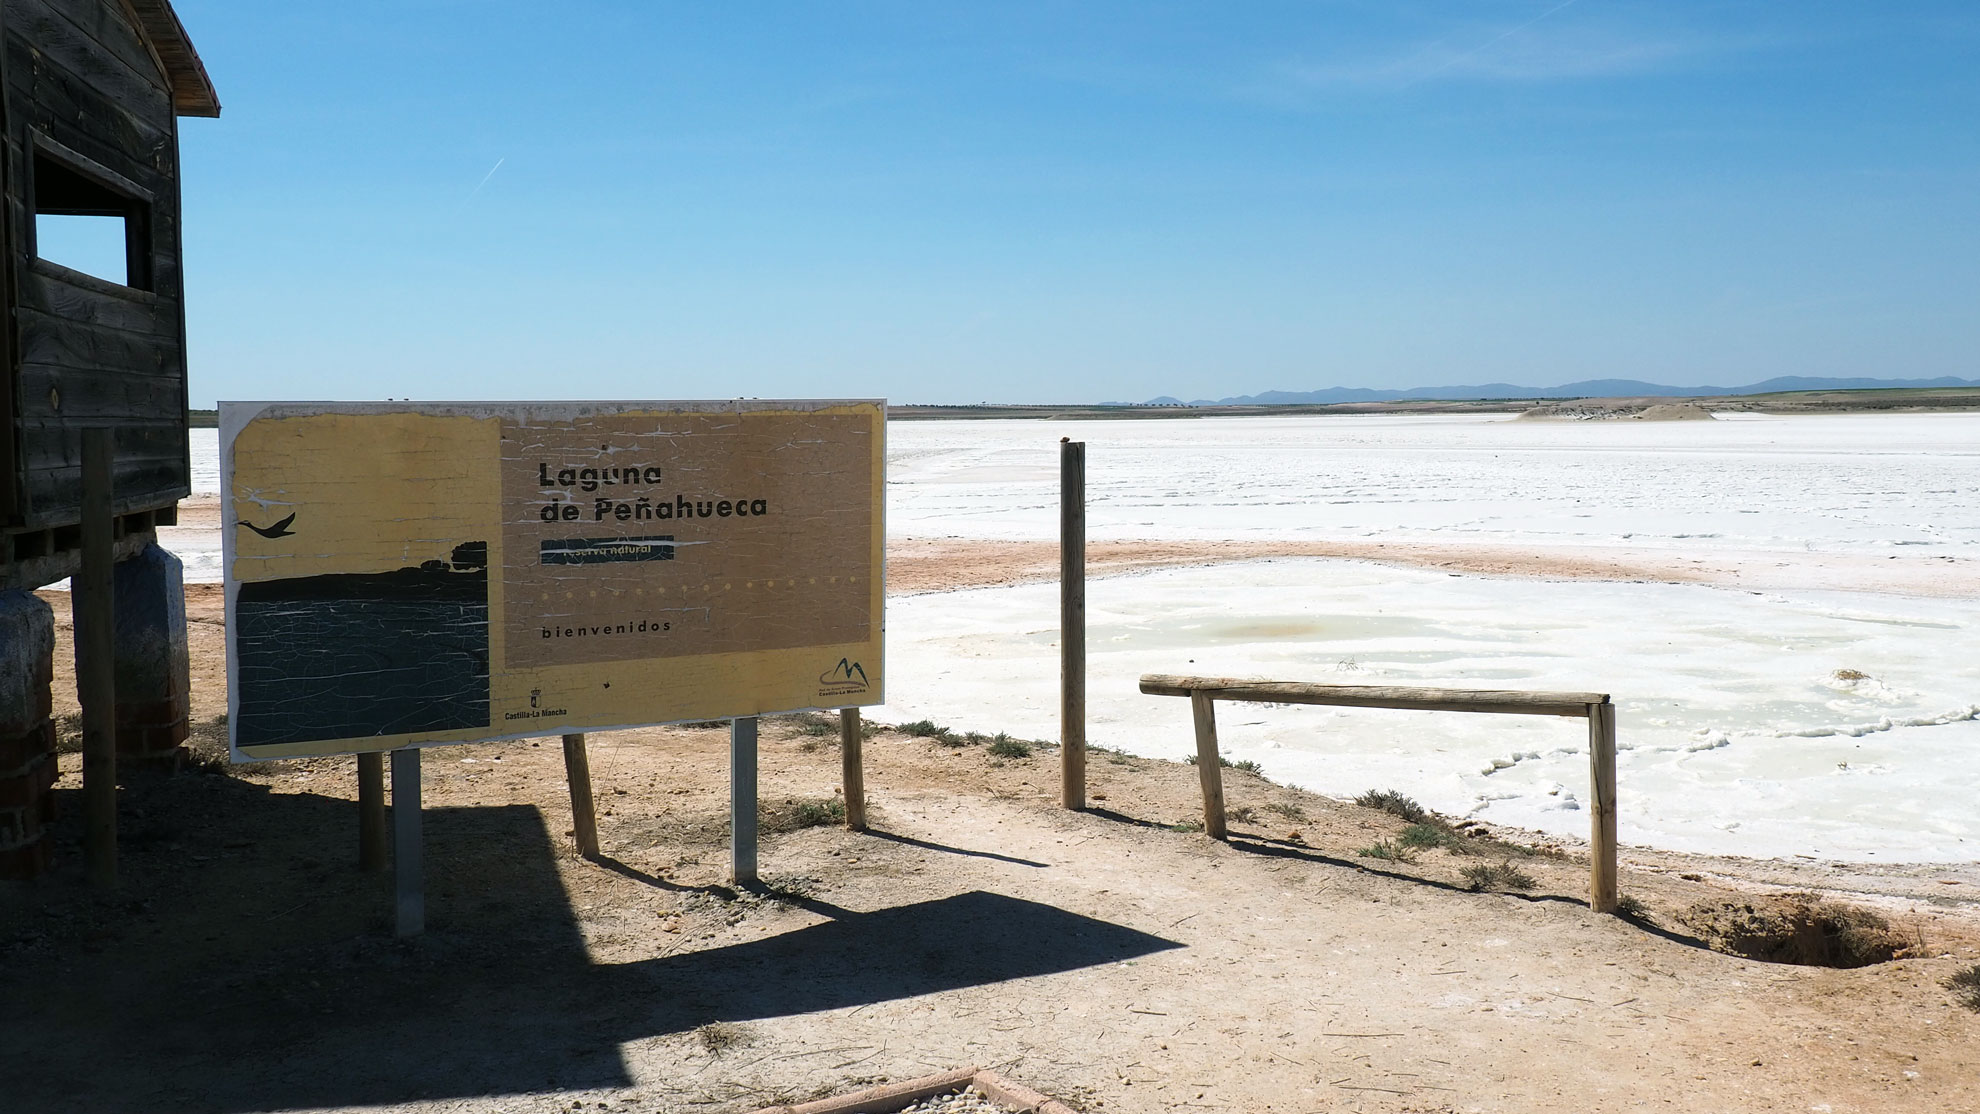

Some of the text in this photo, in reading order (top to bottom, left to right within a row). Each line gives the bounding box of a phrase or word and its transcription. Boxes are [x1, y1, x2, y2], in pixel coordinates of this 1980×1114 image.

[539, 462, 661, 491] Laguna
[540, 495, 767, 523] de Peñahueca
[610, 545, 651, 555] natural
[542, 620, 671, 638] bienvenidos
